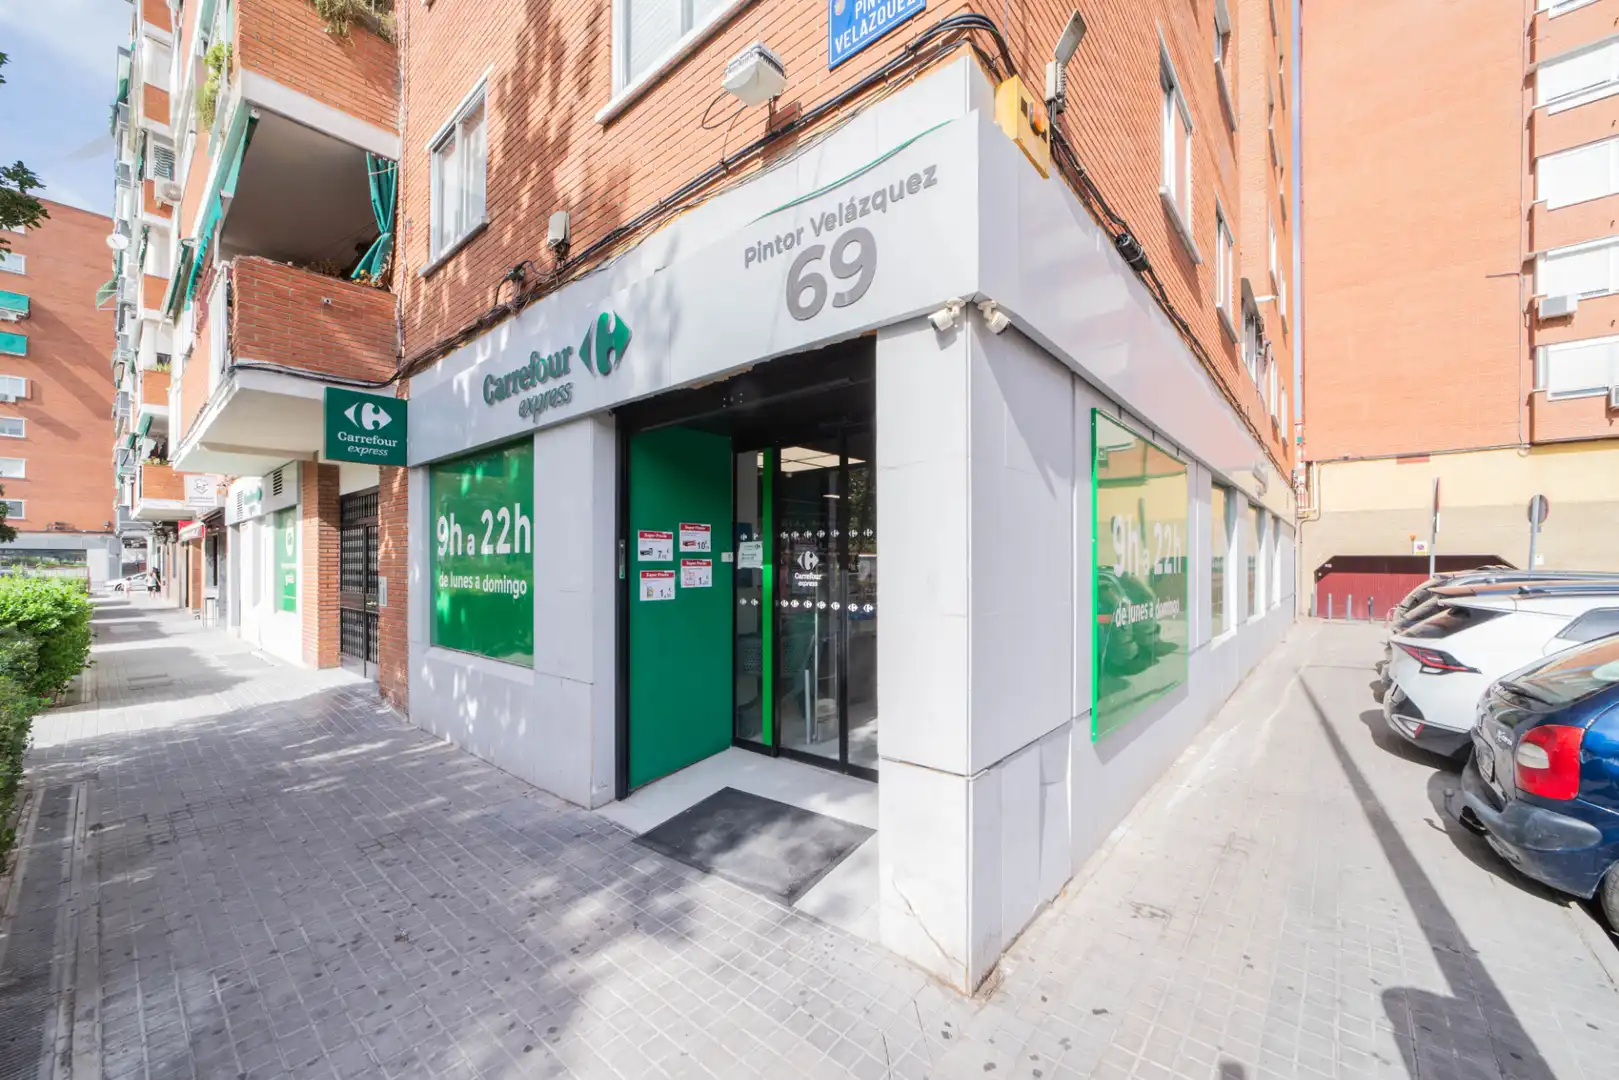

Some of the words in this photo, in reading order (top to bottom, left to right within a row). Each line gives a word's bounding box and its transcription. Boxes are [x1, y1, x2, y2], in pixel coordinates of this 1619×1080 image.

[744, 226, 804, 269] Pintor
[809, 164, 938, 237] Velázquez
[786, 226, 878, 321] 69
[483, 346, 574, 406] Carrefour
[518, 382, 574, 424] express
[337, 431, 398, 447] Carrefour
[347, 445, 389, 456] express
[437, 512, 462, 556] 9h
[467, 533, 476, 556] a
[481, 502, 531, 554] 22h
[1112, 514, 1139, 578] 9h
[1143, 547, 1150, 575] a
[1153, 520, 1181, 575] 22h
[438, 571, 449, 587] de
[450, 571, 473, 589] lunes
[475, 575, 481, 589] a
[482, 574, 527, 599] domingo
[794, 572, 822, 580] Carrefour
[1115, 601, 1127, 628] de
[1128, 600, 1148, 624] lunes
[1149, 601, 1155, 618] a
[1155, 597, 1180, 619] domingo
